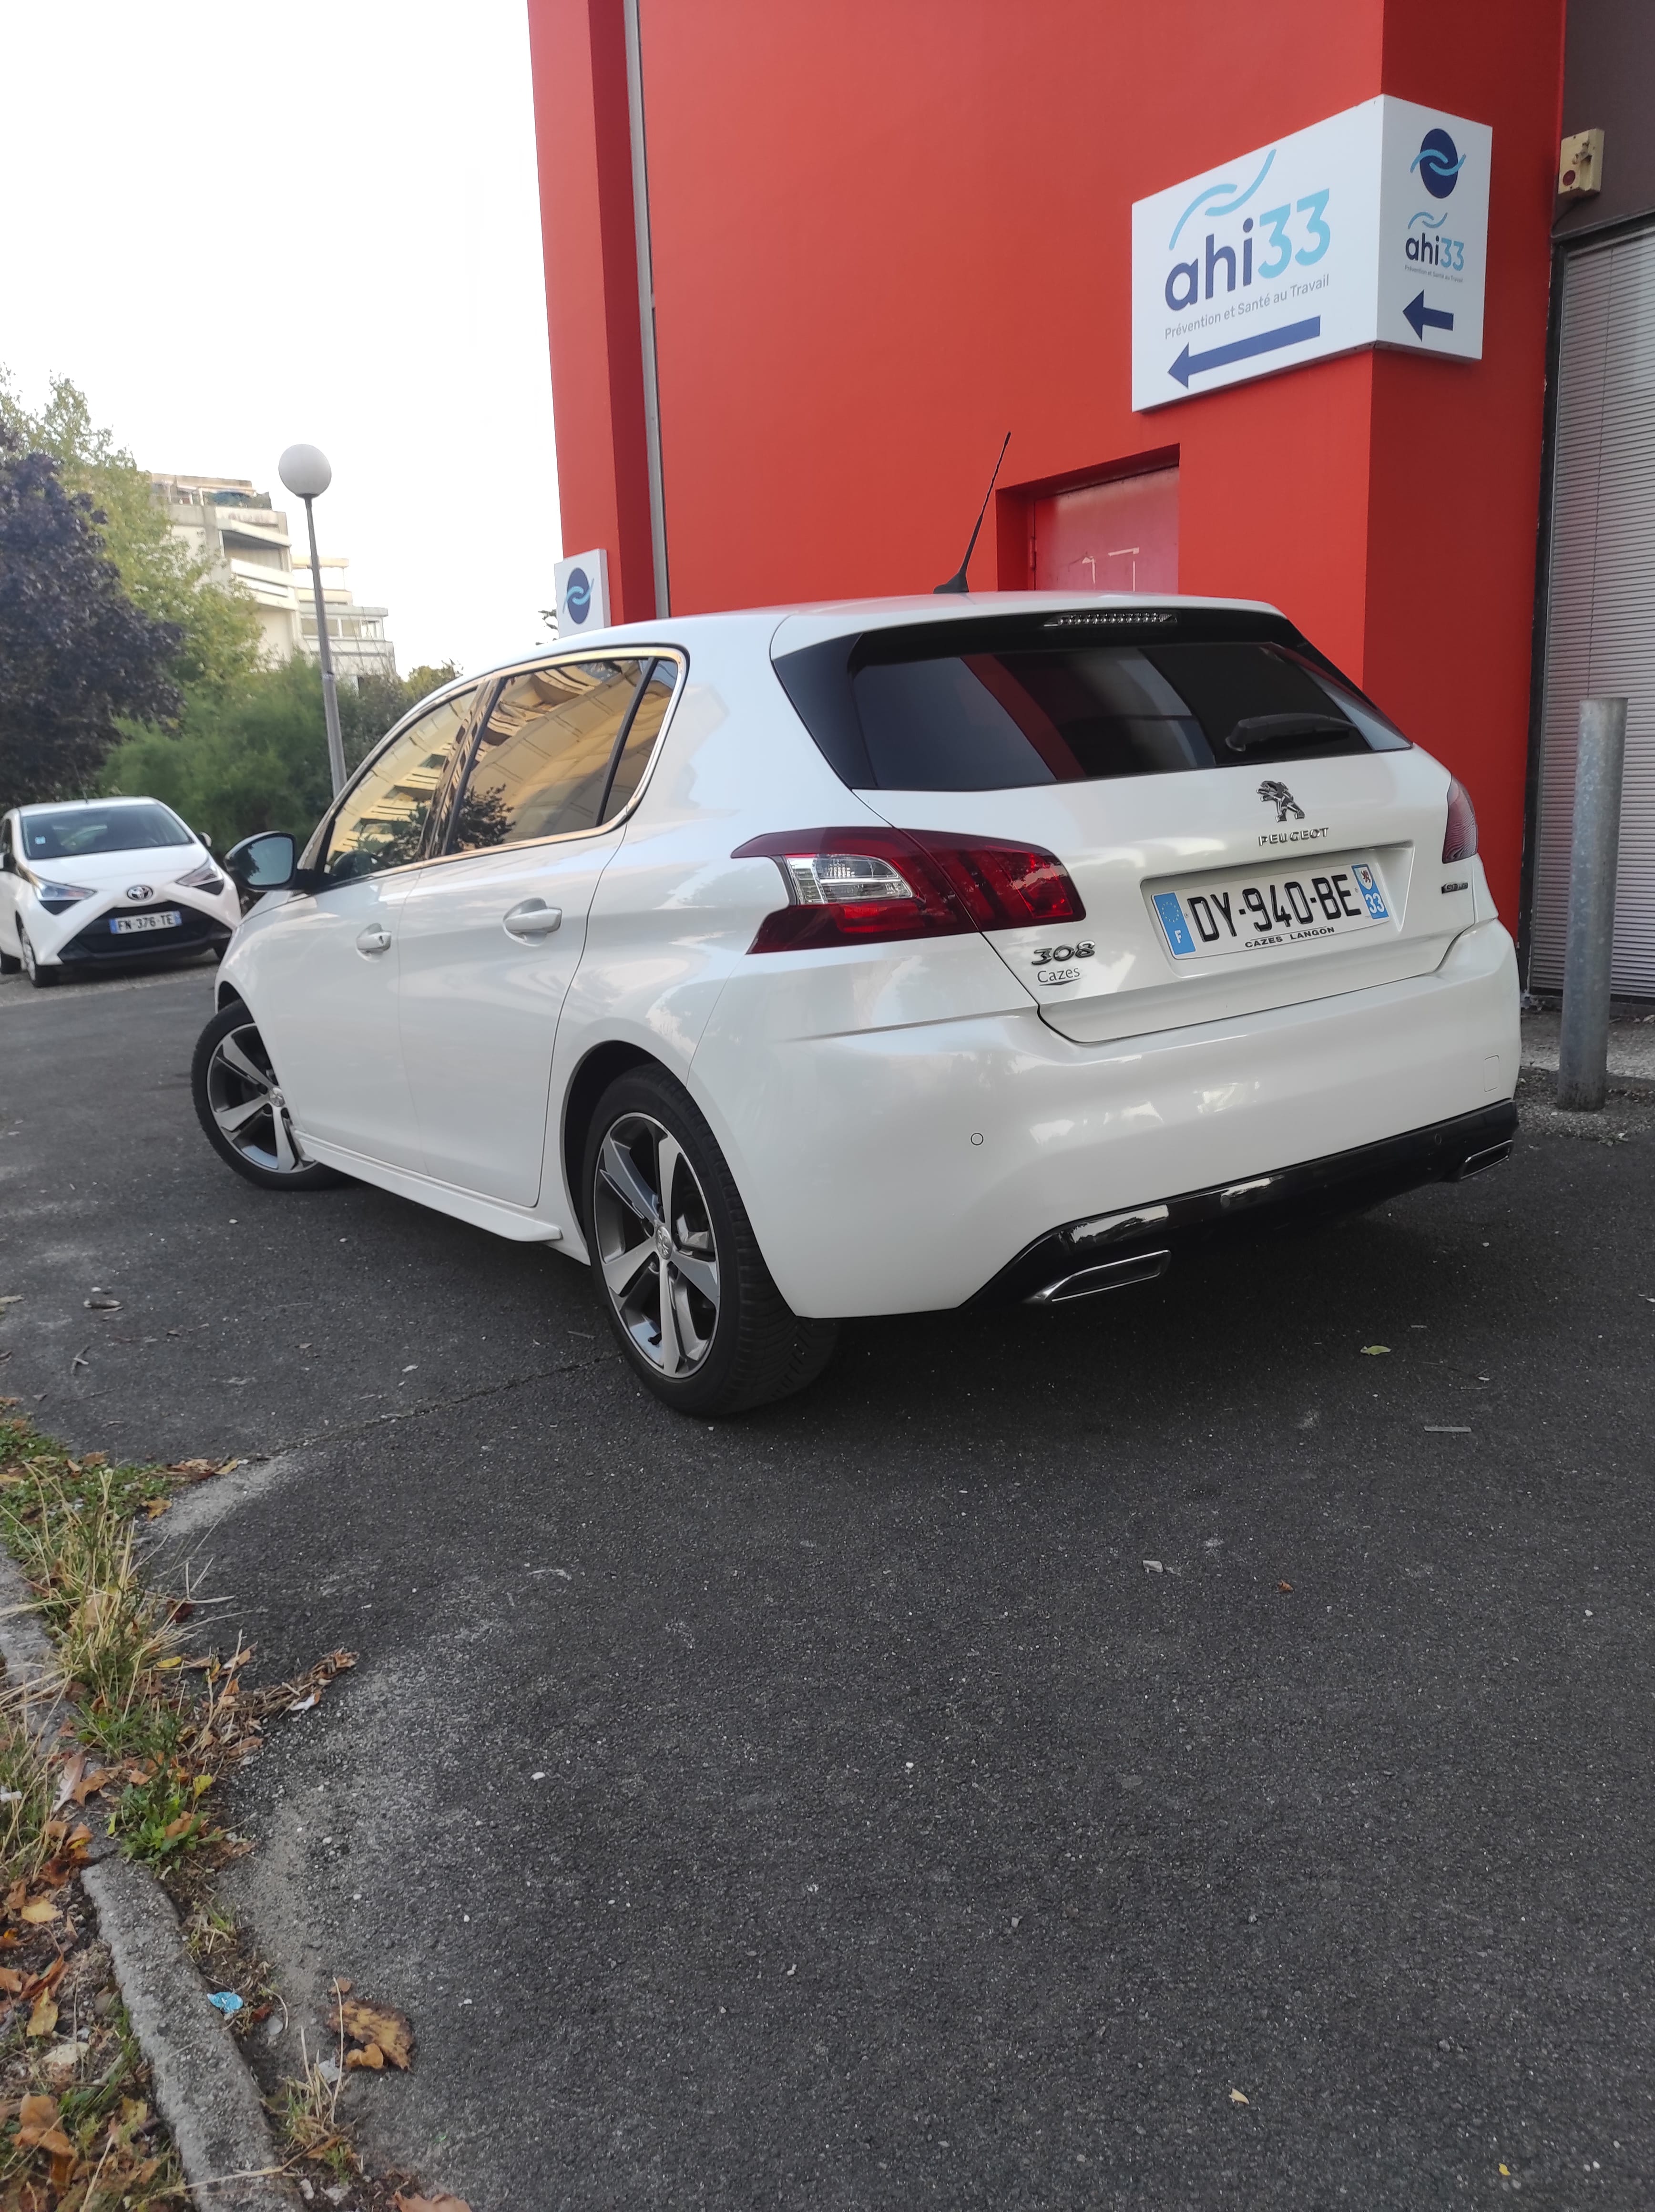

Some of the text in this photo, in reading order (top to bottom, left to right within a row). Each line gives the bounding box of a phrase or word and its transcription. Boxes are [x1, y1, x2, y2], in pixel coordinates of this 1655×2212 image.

[1165, 188, 1331, 311] ahi33
[1405, 232, 1464, 271] ahi33
[1165, 273, 1329, 339] Prévention et Santé au Travail
[1258, 827, 1329, 847] PEUGEOT
[1174, 874, 1385, 944] F DY-940-BE 33
[1032, 940, 1095, 965] 308
[1245, 926, 1335, 948] CAZES LANGON
[1037, 967, 1080, 983] Cazes
